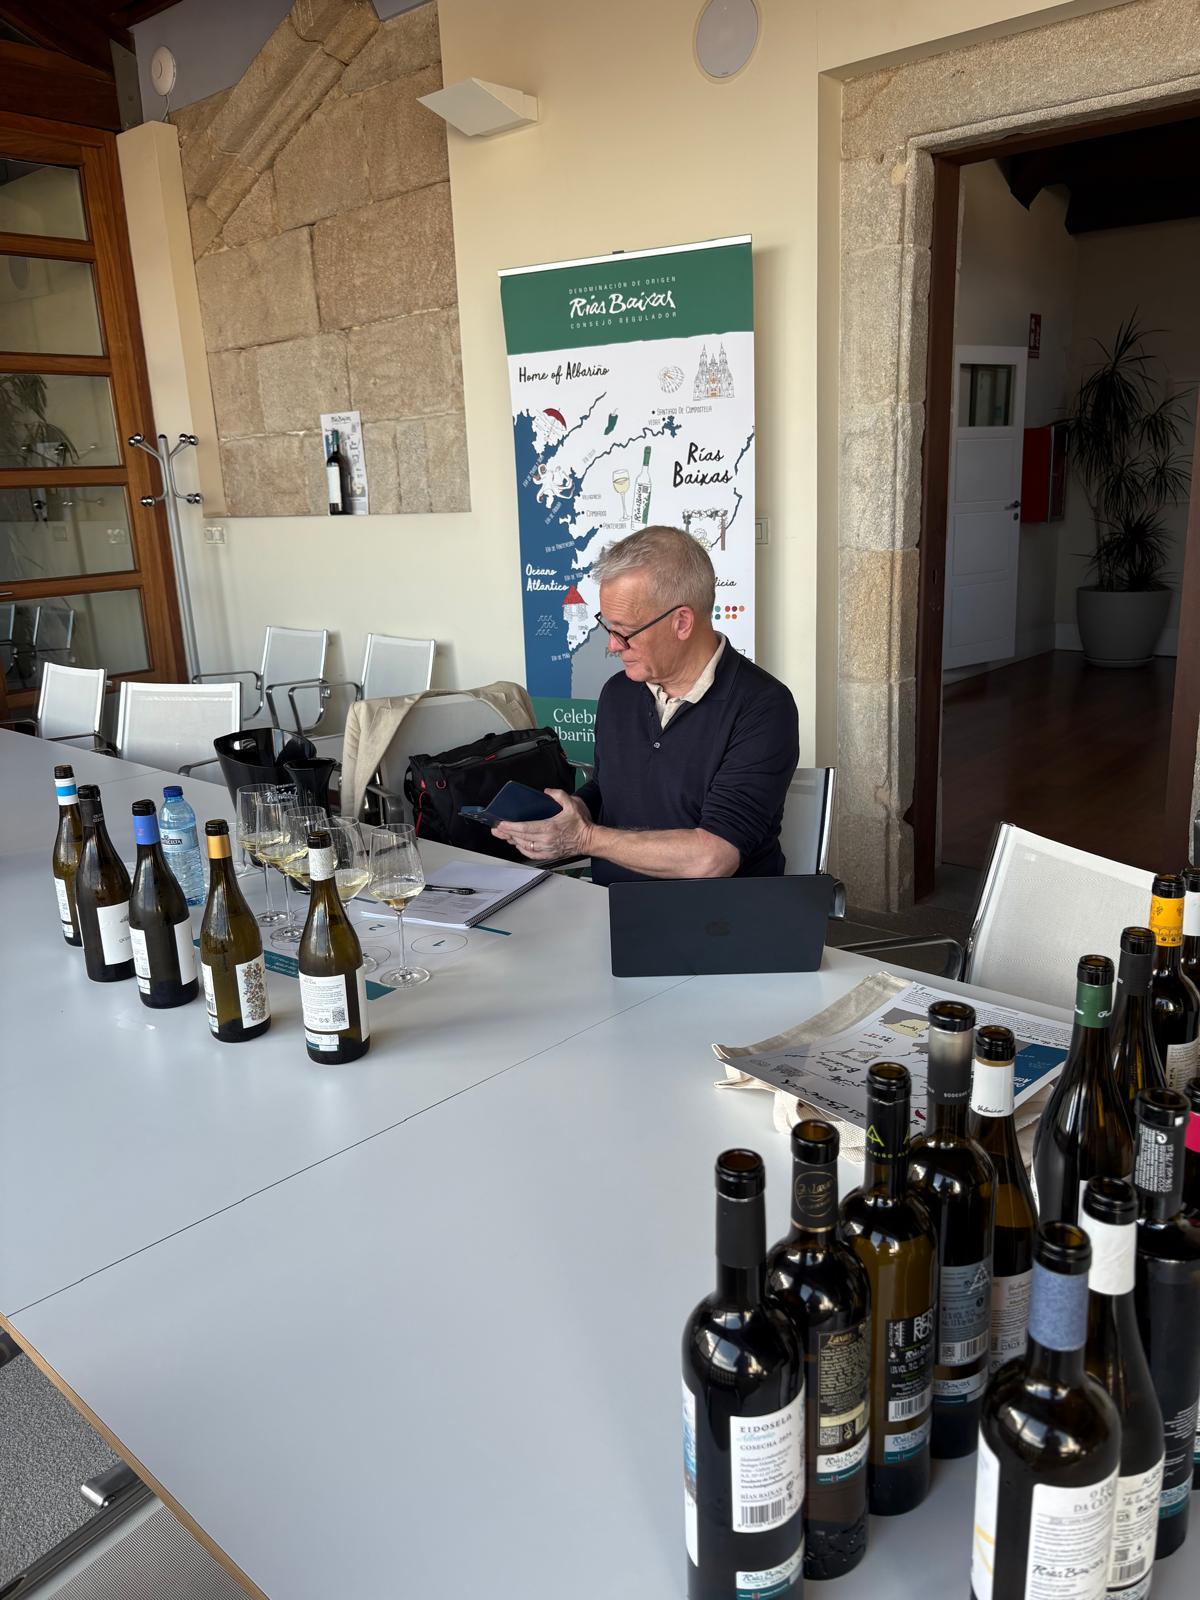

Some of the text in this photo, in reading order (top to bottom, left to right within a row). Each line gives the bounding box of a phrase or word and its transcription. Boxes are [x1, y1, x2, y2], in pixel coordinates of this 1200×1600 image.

[568, 282, 628, 295] DENOMINACIÓN
[645, 275, 676, 285] ORIGEN
[568, 289, 677, 319] Rías Baixas
[570, 311, 677, 330] CONSEJO REGULADOR
[518, 361, 610, 385] Home of Albariño
[686, 441, 725, 465] Rías
[672, 460, 733, 488] Baixas
[553, 707, 597, 725] Celeb
[553, 725, 597, 743] lbariñ
[739, 1413, 793, 1434] EIDOSELA
[739, 1441, 777, 1451] COSECHA
